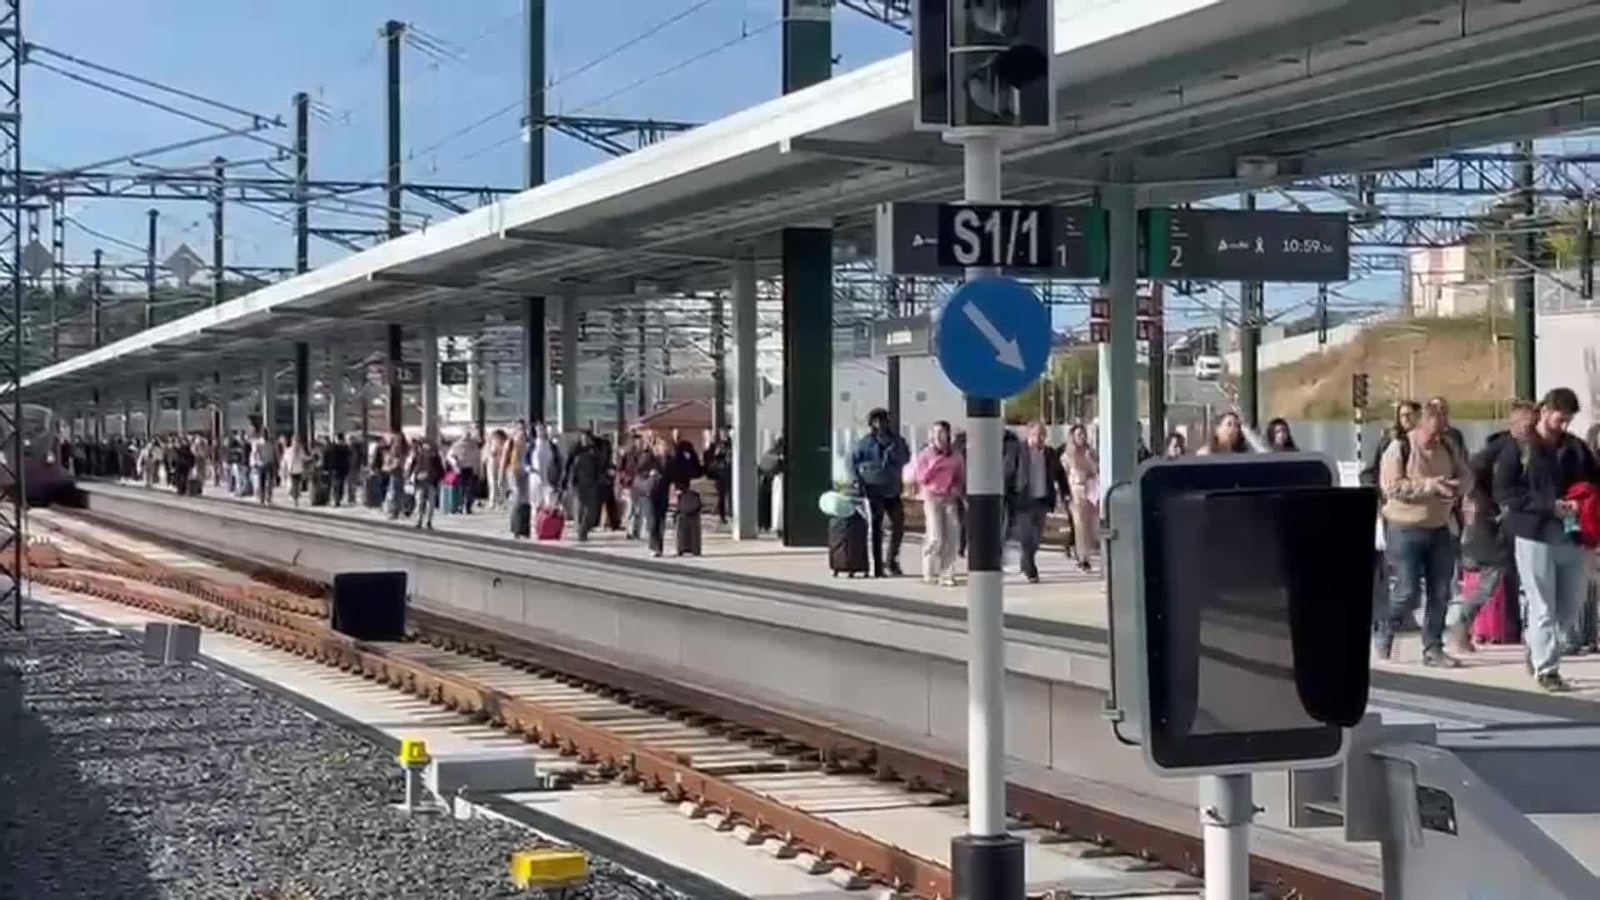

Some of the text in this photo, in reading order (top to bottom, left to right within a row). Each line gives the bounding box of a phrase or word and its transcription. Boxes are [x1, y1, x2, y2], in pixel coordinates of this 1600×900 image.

[952, 209, 1039, 265] S1/1
[1056, 244, 1067, 266] 1
[1170, 245, 1183, 267] 2
